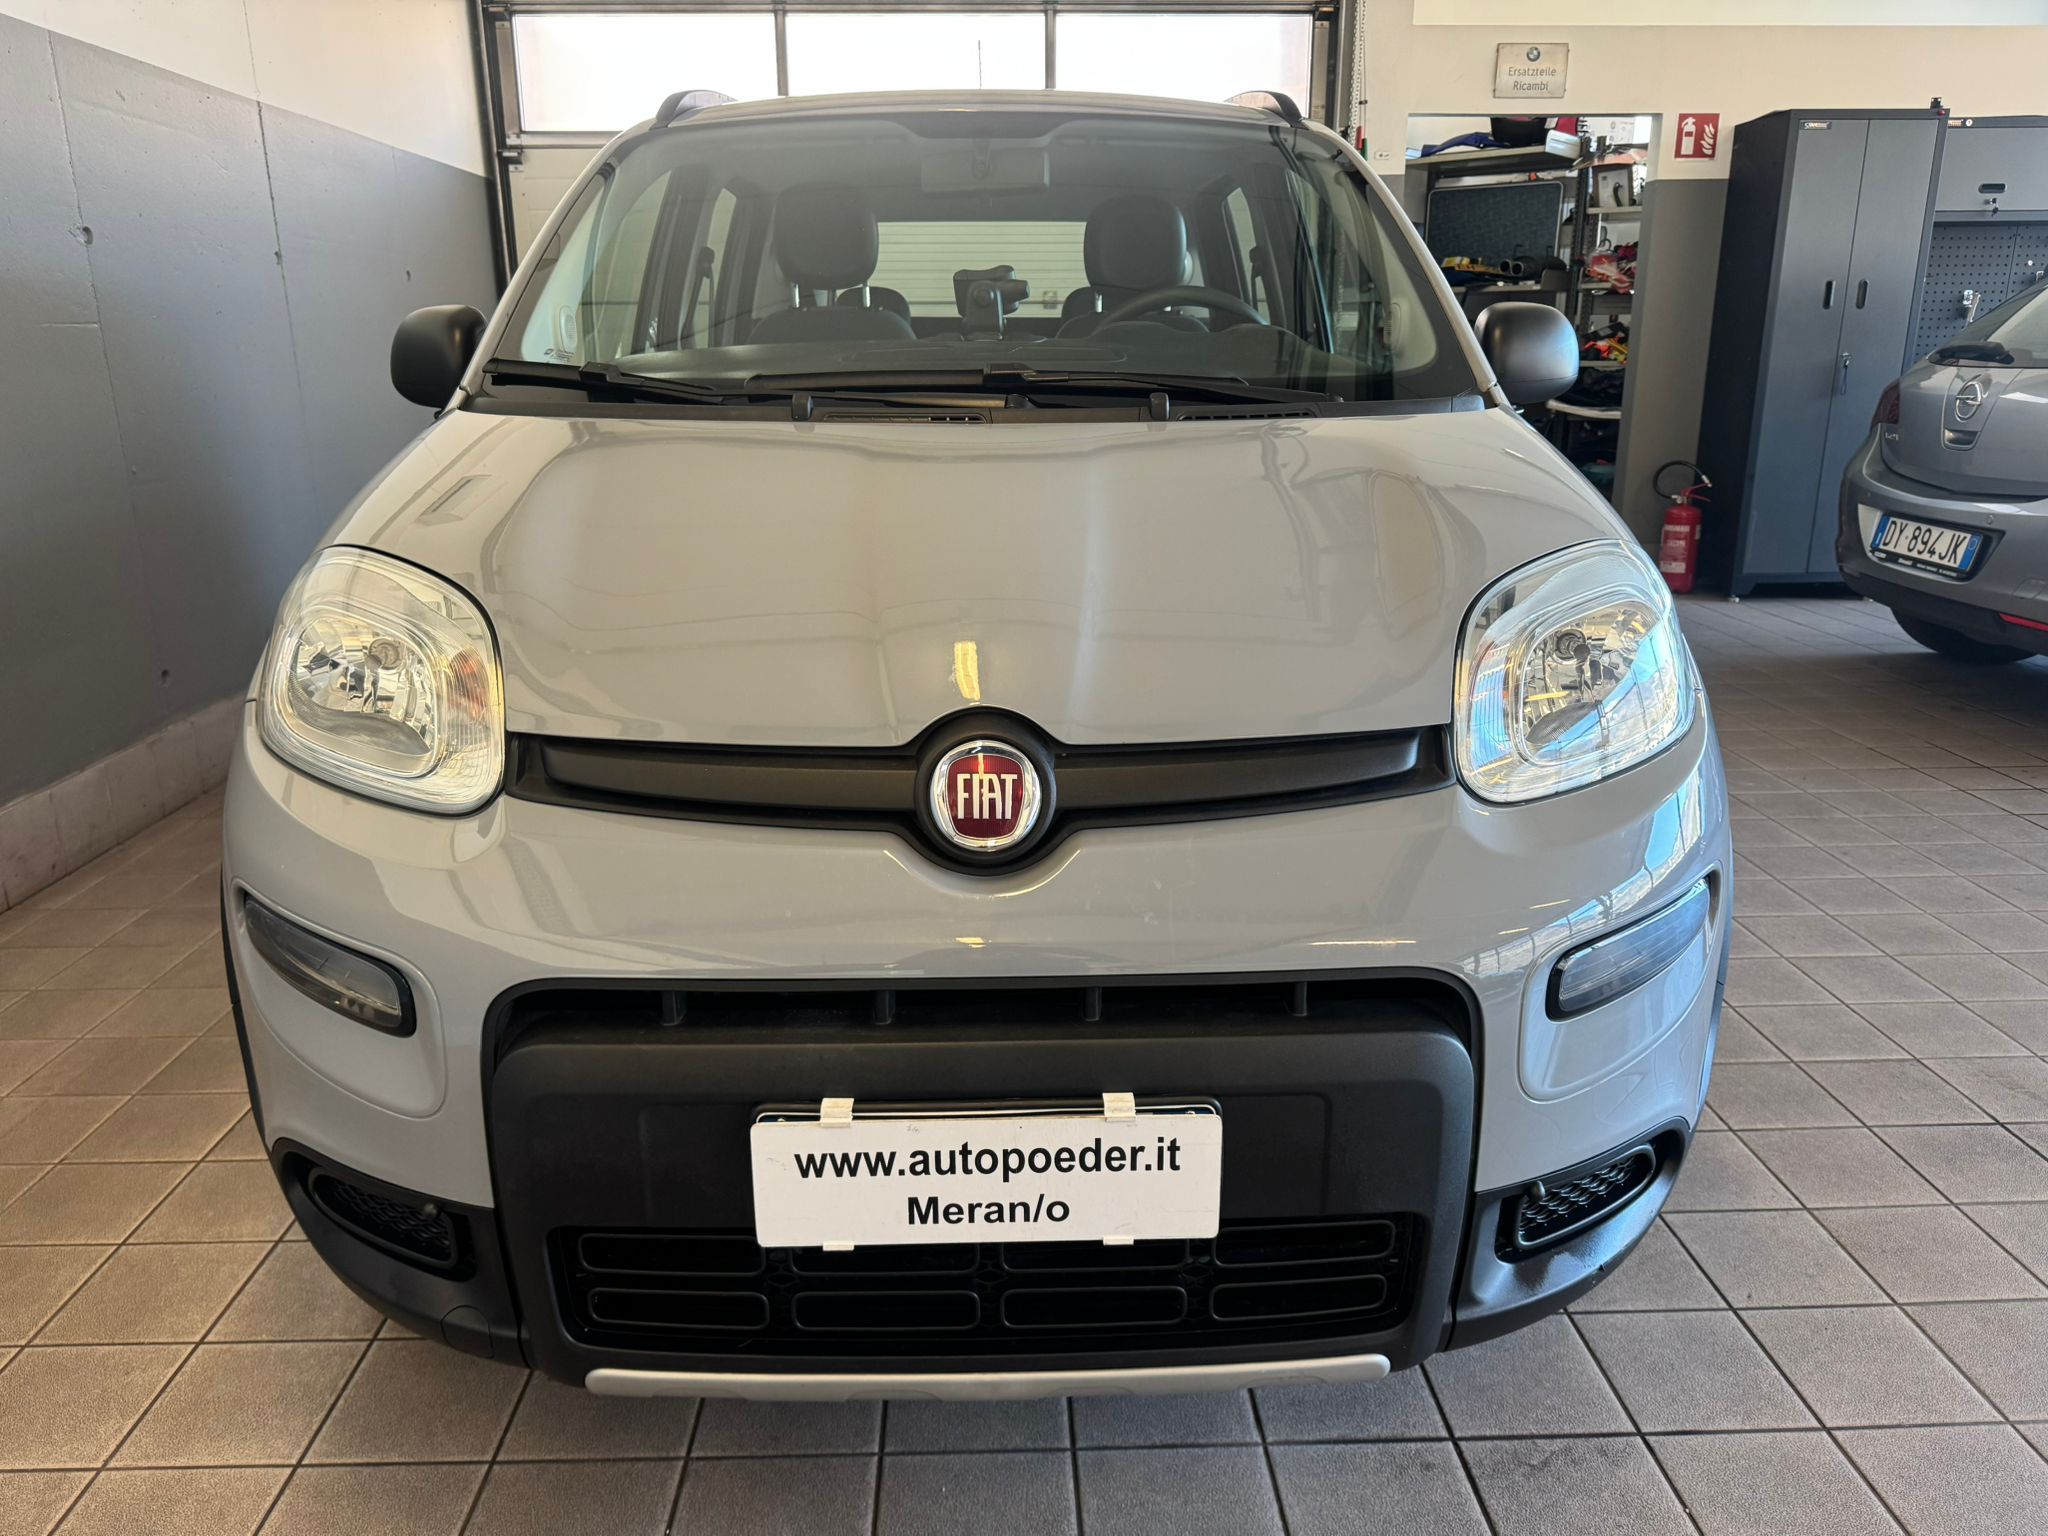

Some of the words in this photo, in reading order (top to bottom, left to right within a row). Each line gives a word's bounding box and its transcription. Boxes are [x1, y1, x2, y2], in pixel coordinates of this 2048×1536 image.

[1508, 66, 1557, 77] Ersatzteile
[1513, 80, 1549, 91] Ricambi
[957, 773, 1018, 820] FIAT
[794, 1136, 1181, 1183] www.autopoeder.it
[907, 1193, 1070, 1225] Meran/o
